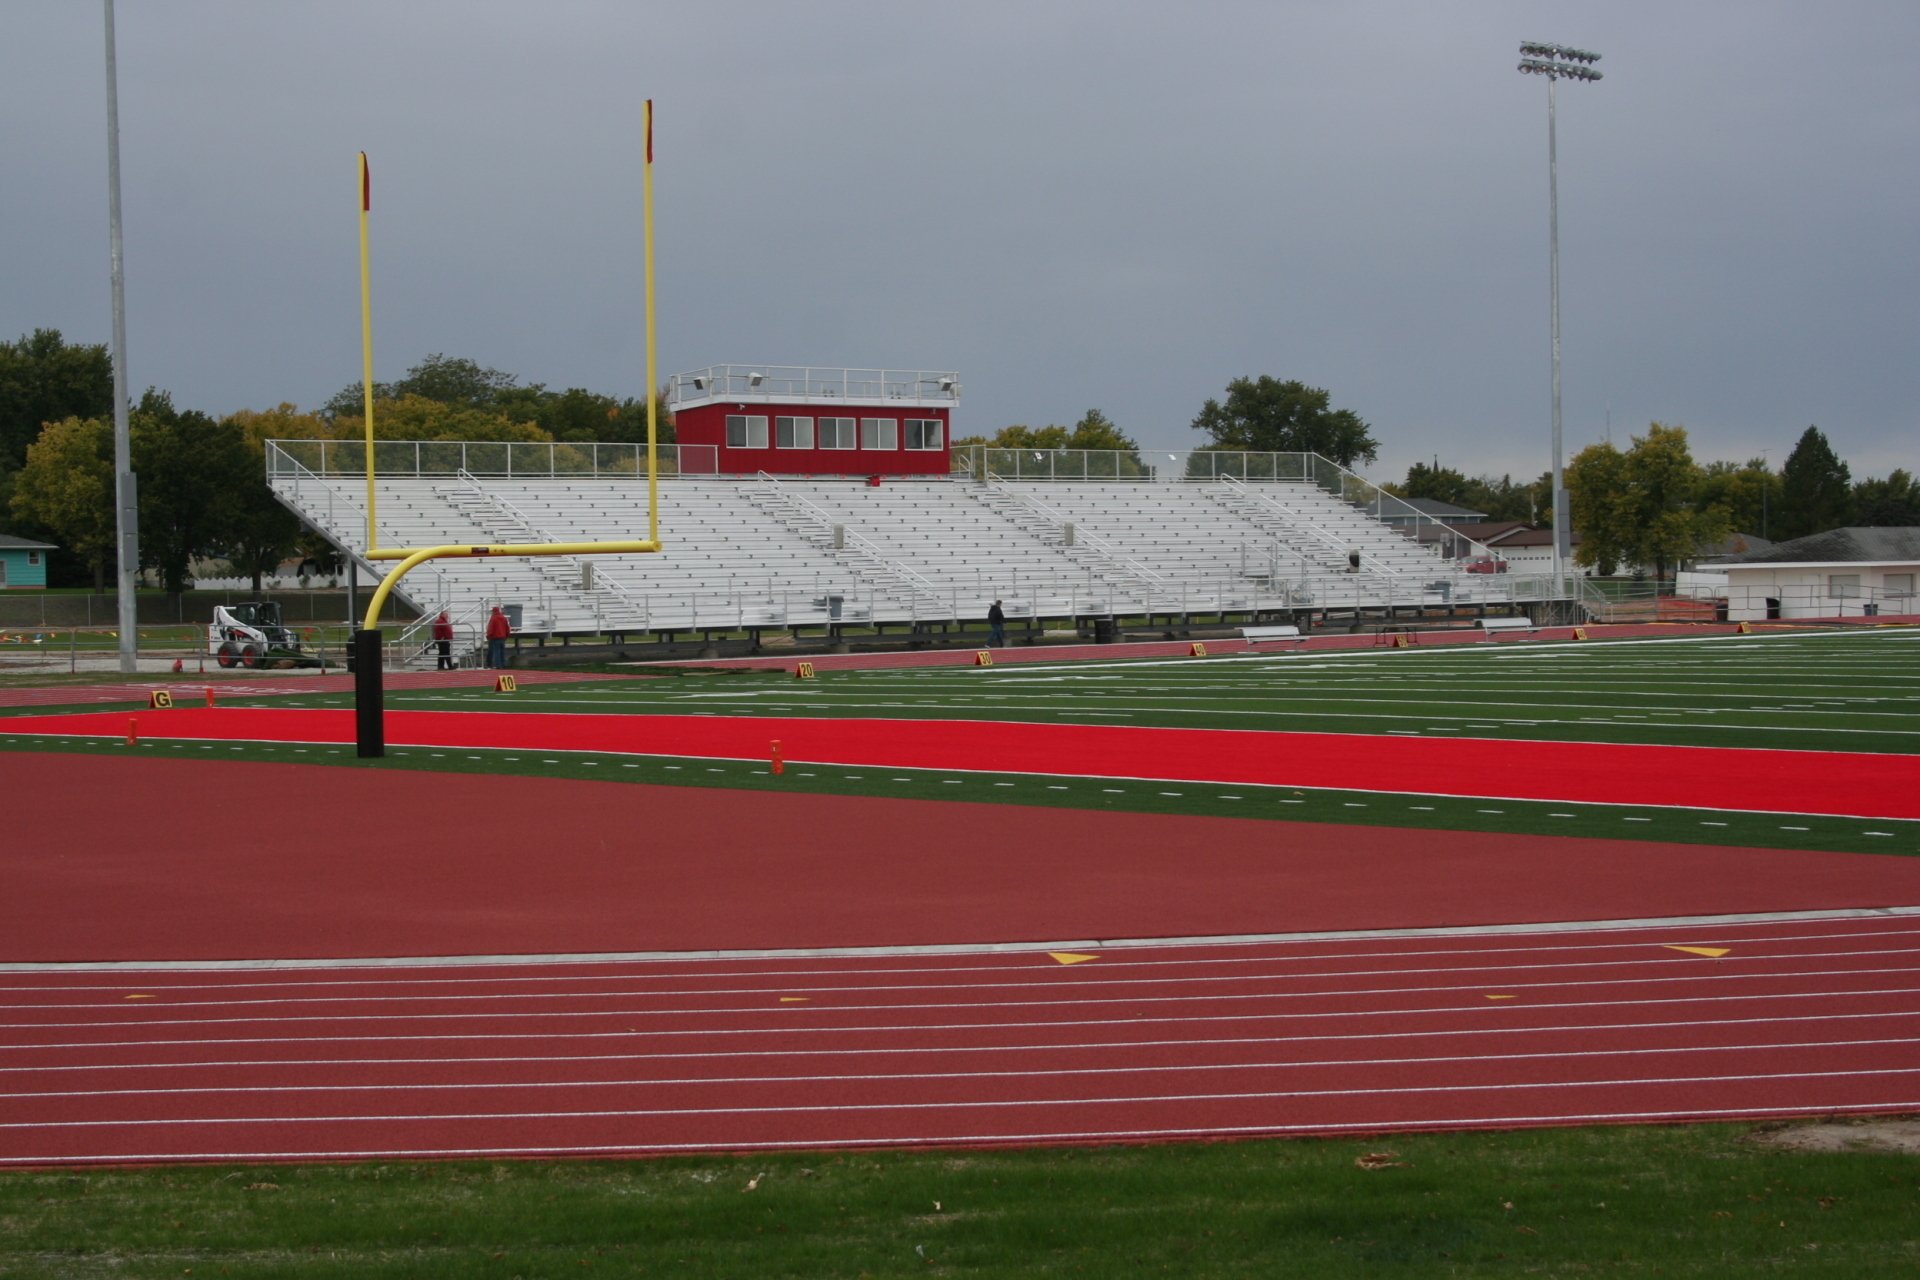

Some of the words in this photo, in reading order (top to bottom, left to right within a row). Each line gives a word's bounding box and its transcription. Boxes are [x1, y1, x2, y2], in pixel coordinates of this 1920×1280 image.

[980, 652, 992, 665] 30
[801, 664, 813, 677] 20
[502, 676, 514, 690] 10
[155, 692, 171, 707] G
